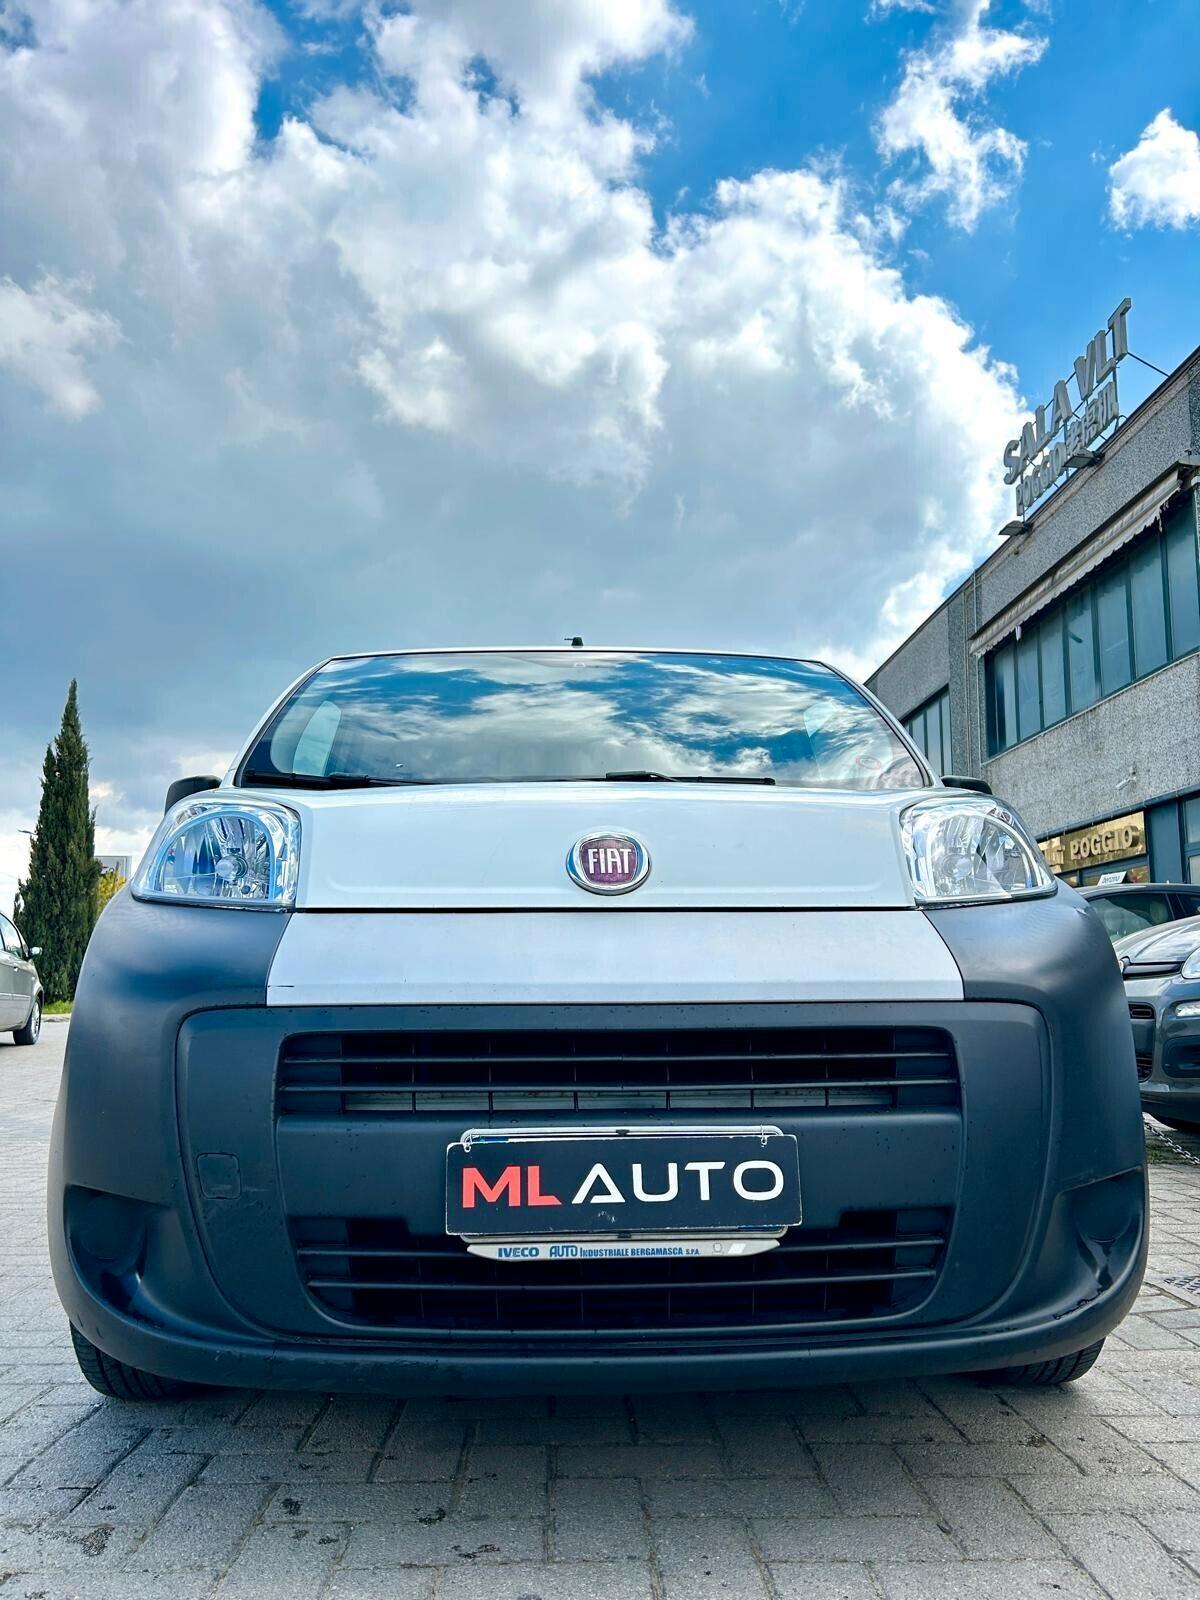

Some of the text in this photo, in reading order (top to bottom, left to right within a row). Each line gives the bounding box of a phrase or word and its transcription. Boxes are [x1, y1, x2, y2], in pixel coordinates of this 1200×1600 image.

[1003, 297, 1131, 485] SALA VLT
[1015, 441, 1067, 516] POGGIO
[587, 848, 632, 874] FIAT
[1070, 826, 1137, 860] POGGIO
[462, 1160, 784, 1208] ML AUTO
[498, 1247, 540, 1258] IVECO
[549, 1245, 578, 1258] AUTO
[630, 1246, 684, 1256] BERGAMASCA
